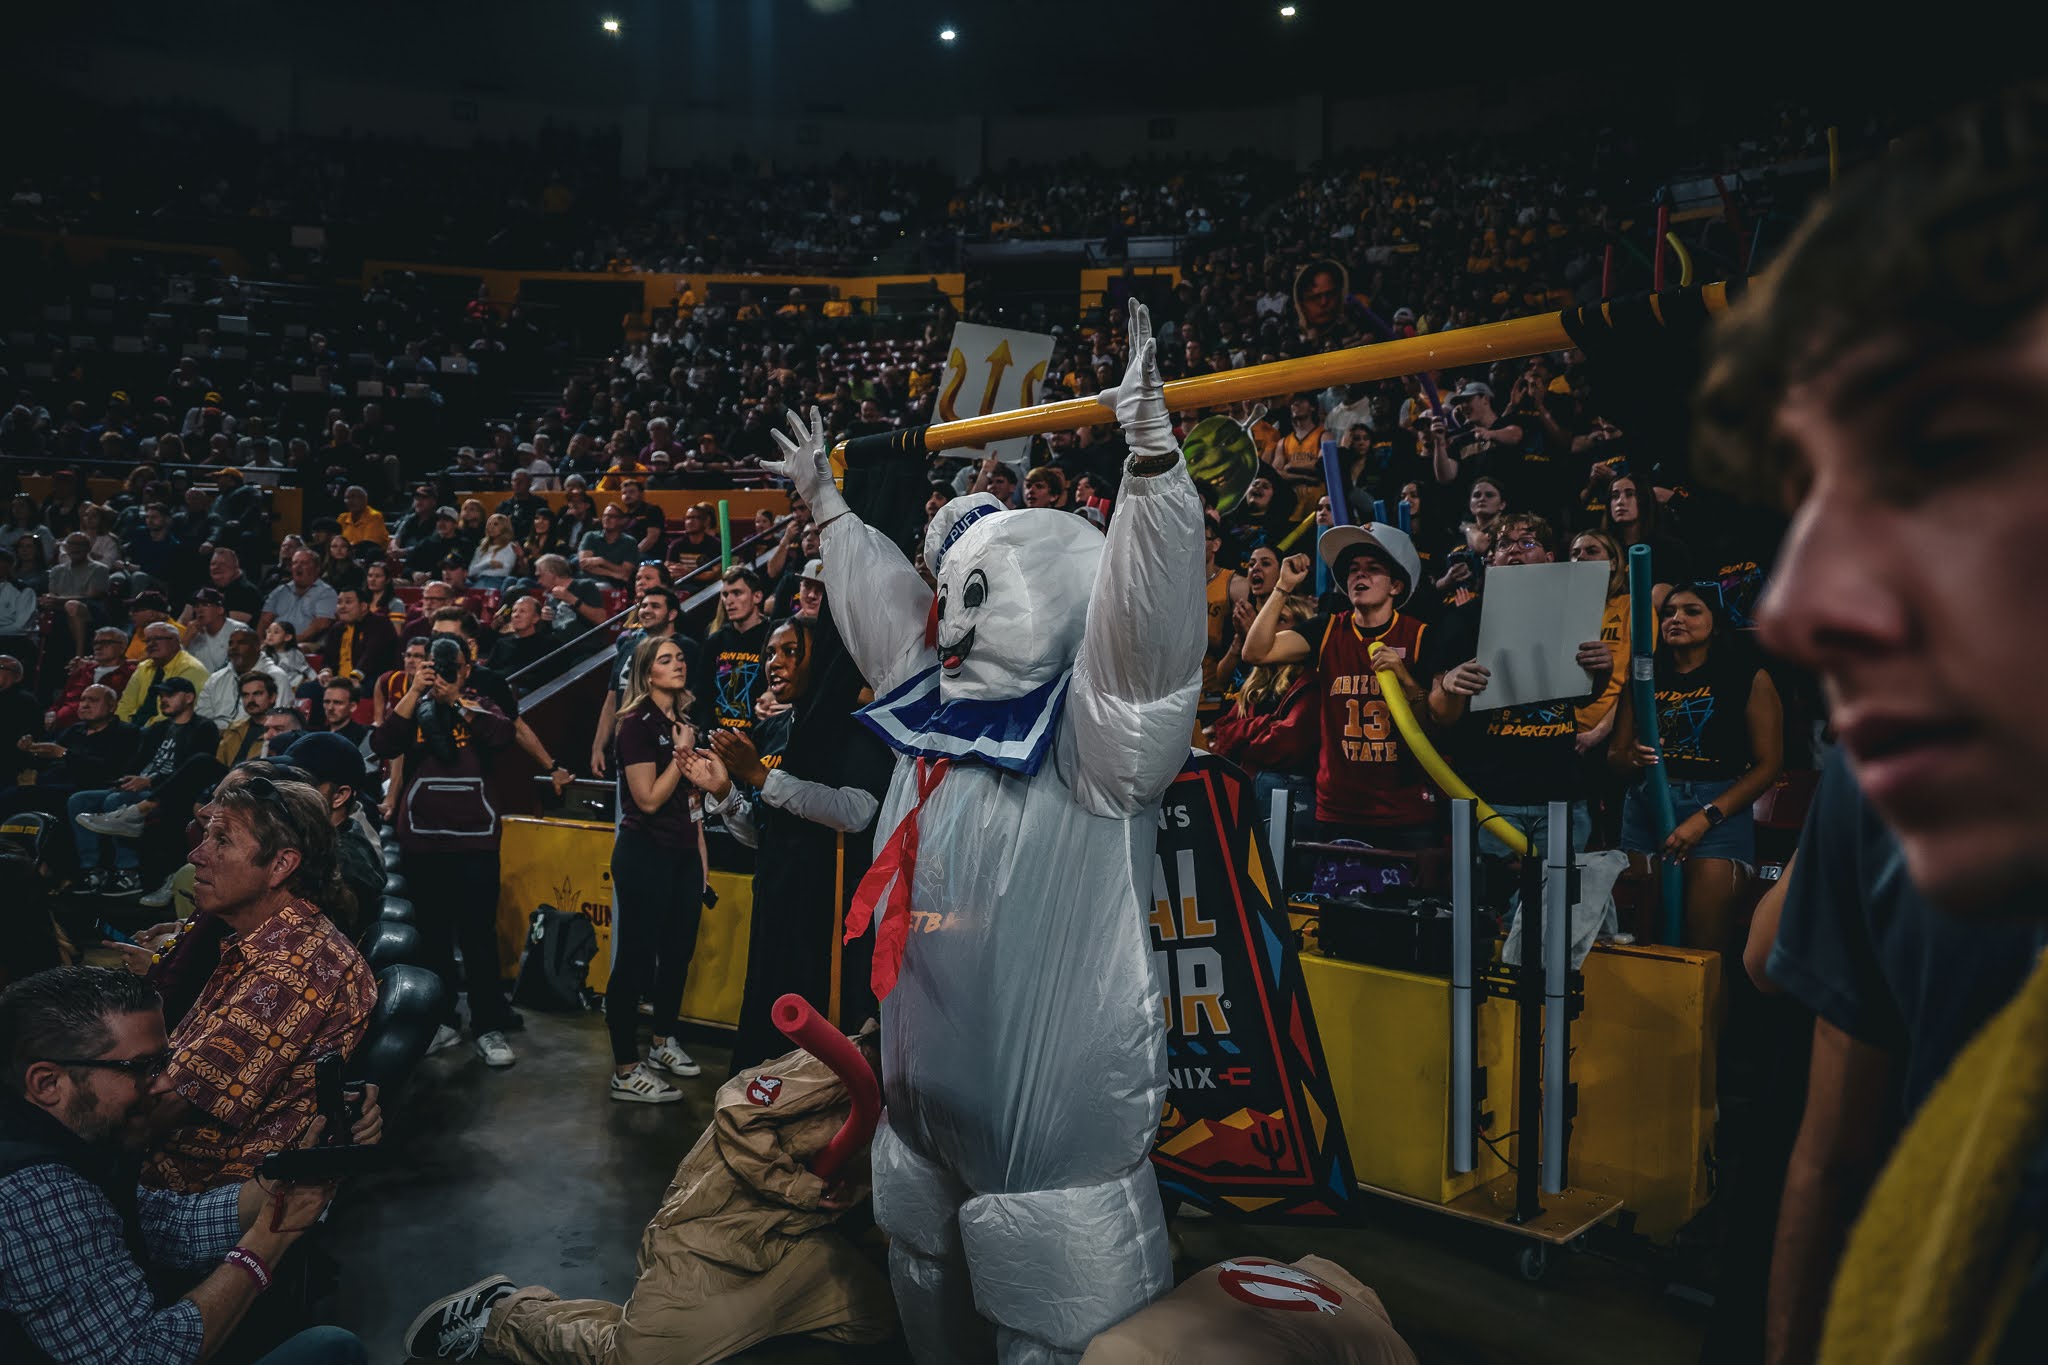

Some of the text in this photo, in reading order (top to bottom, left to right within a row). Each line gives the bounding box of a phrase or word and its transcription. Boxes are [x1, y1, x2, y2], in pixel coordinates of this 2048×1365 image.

[950, 509, 981, 541] PUFT
[1344, 698, 1391, 740] 13
[1765, 867, 1778, 879] 12
